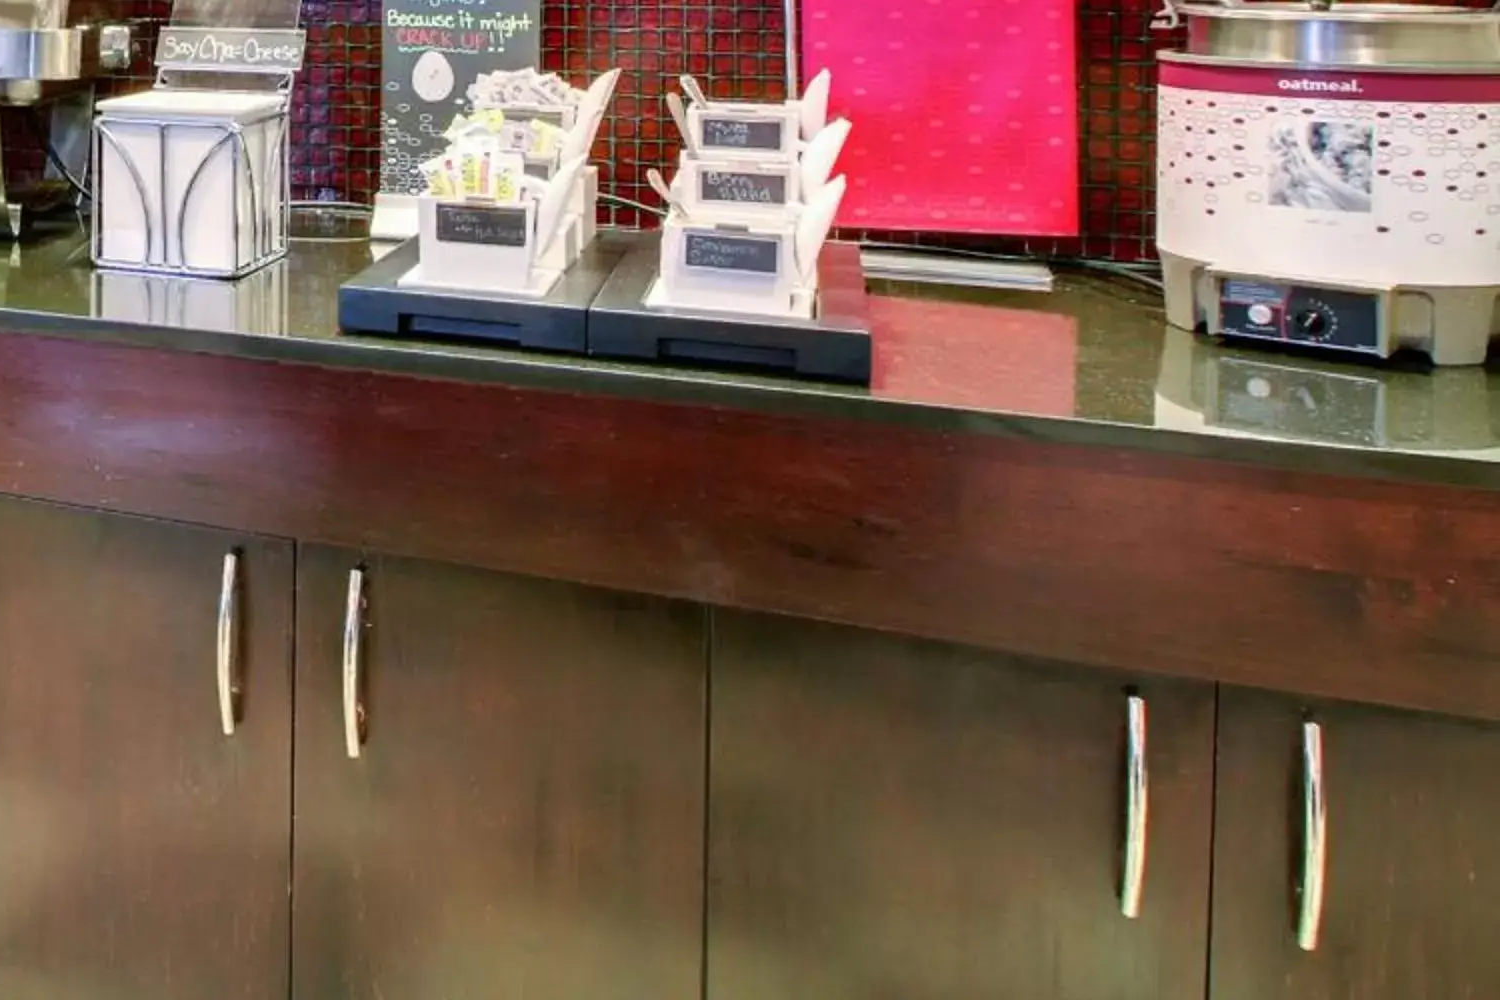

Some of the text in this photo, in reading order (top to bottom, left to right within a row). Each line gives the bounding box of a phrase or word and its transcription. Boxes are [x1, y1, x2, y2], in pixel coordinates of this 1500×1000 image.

[387, 8, 534, 37] Because it might
[395, 27, 453, 47] CRACK
[163, 36, 199, 63] Say
[1277, 78, 1365, 93] oatmeal.
